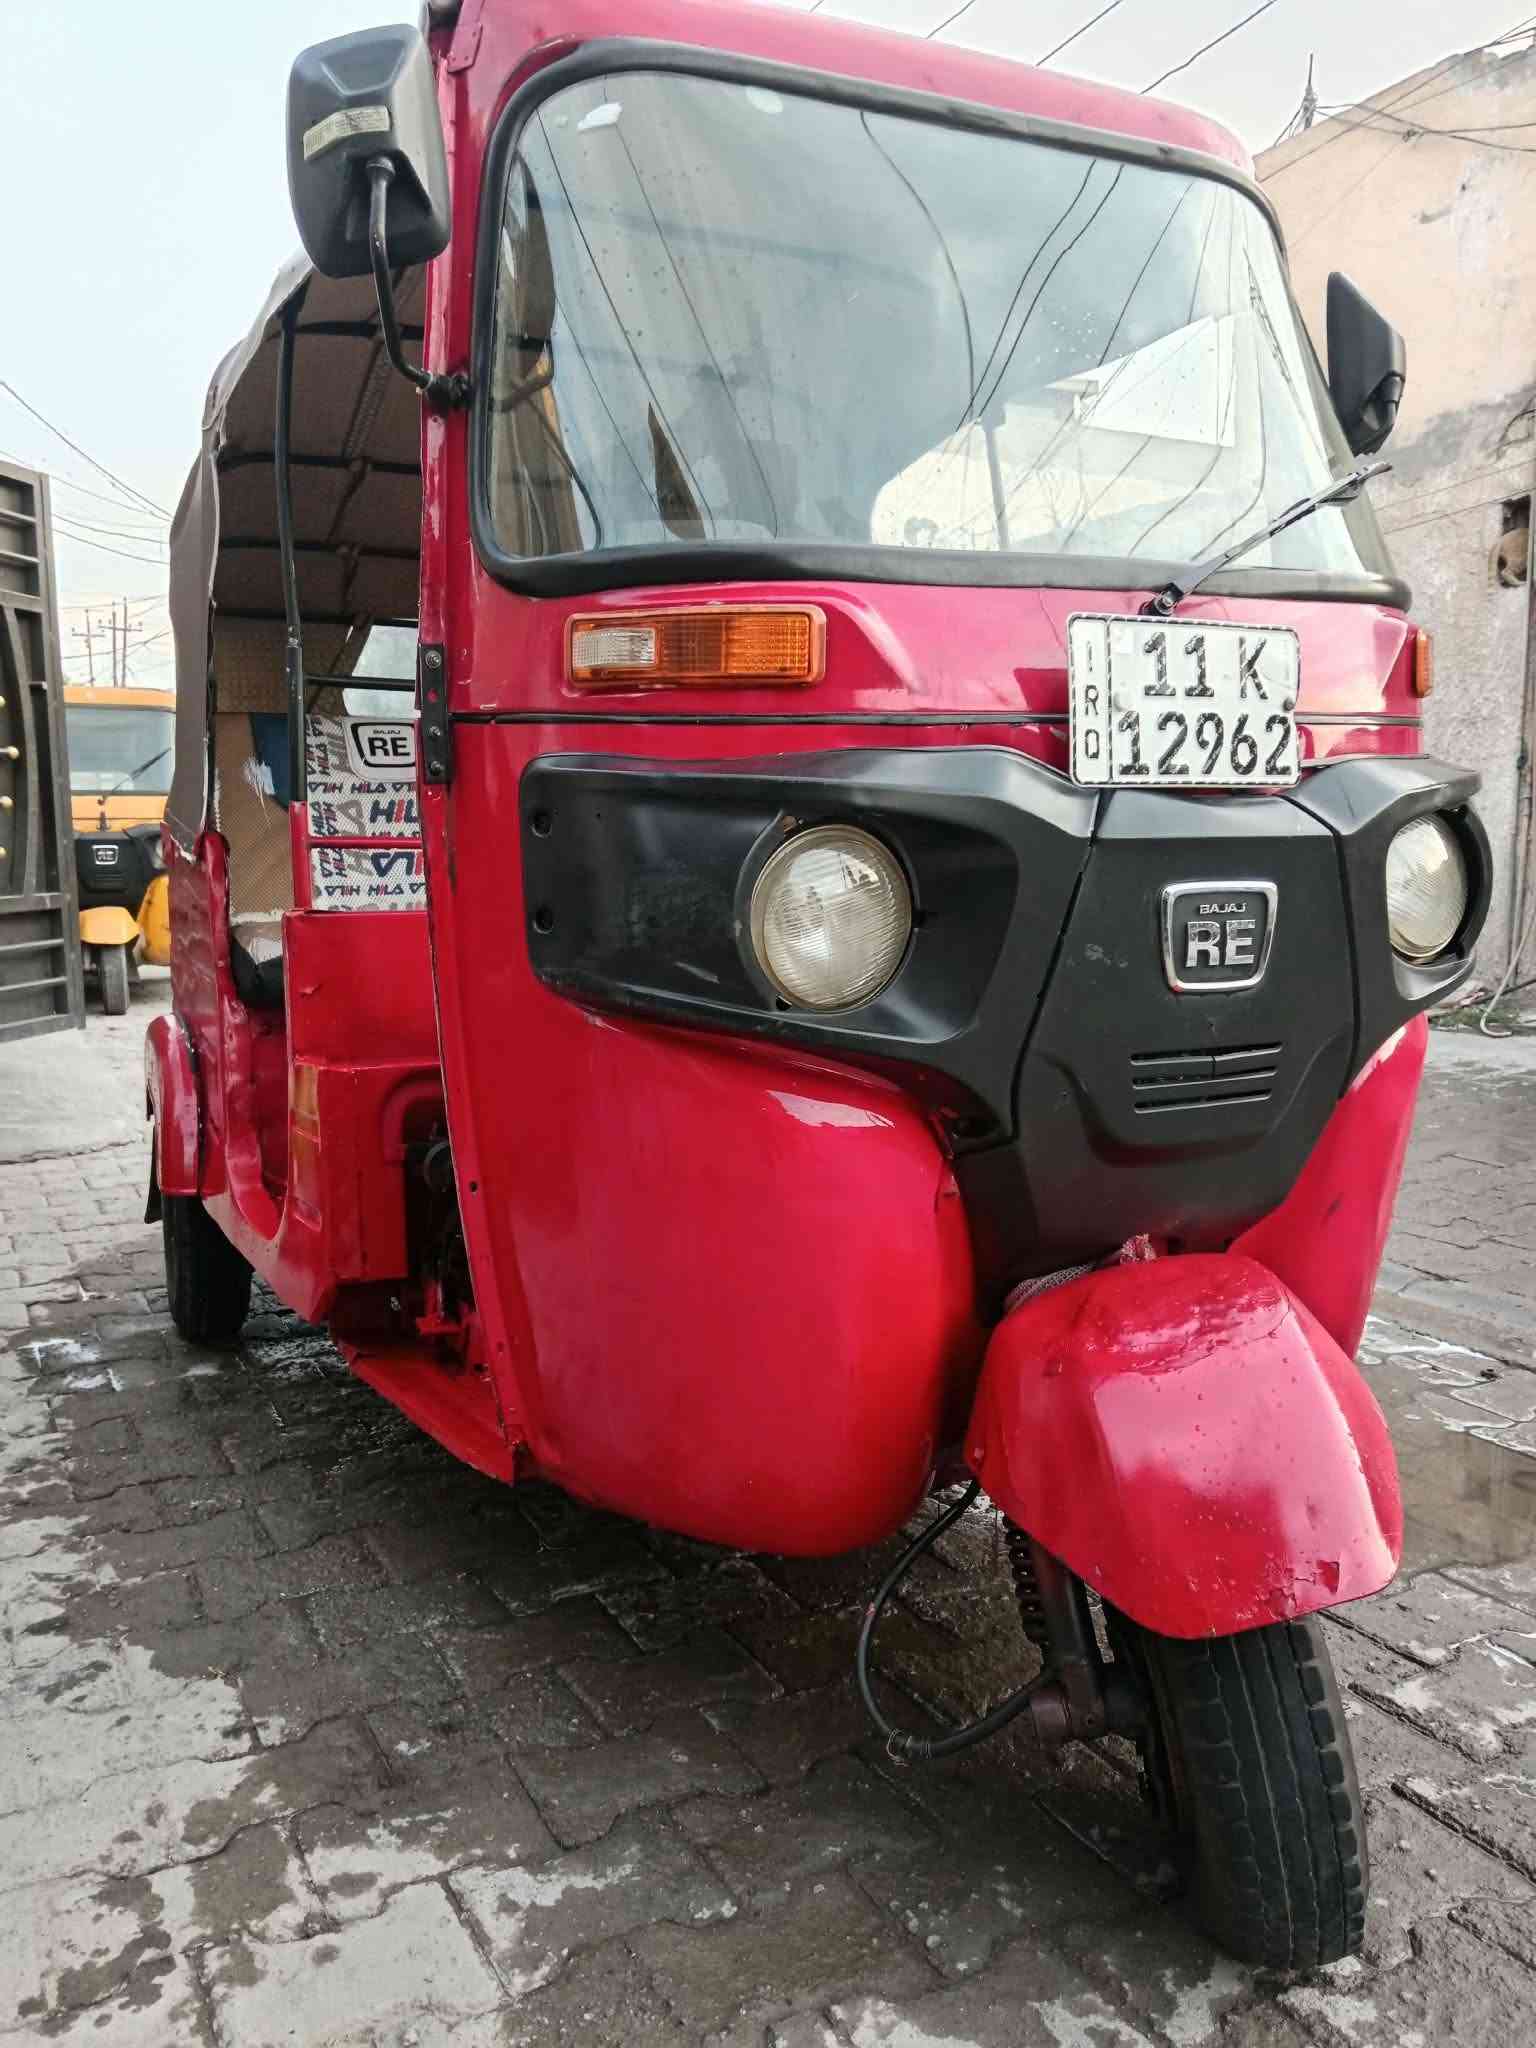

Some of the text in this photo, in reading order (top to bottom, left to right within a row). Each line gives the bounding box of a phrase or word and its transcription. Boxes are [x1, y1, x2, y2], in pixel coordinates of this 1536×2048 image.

[1143, 631, 1268, 700] 11 K
[368, 737, 410, 757] RE
[1118, 710, 1292, 776] 12962
[1199, 902, 1248, 915] BAJAJ
[1185, 919, 1256, 968] RE
